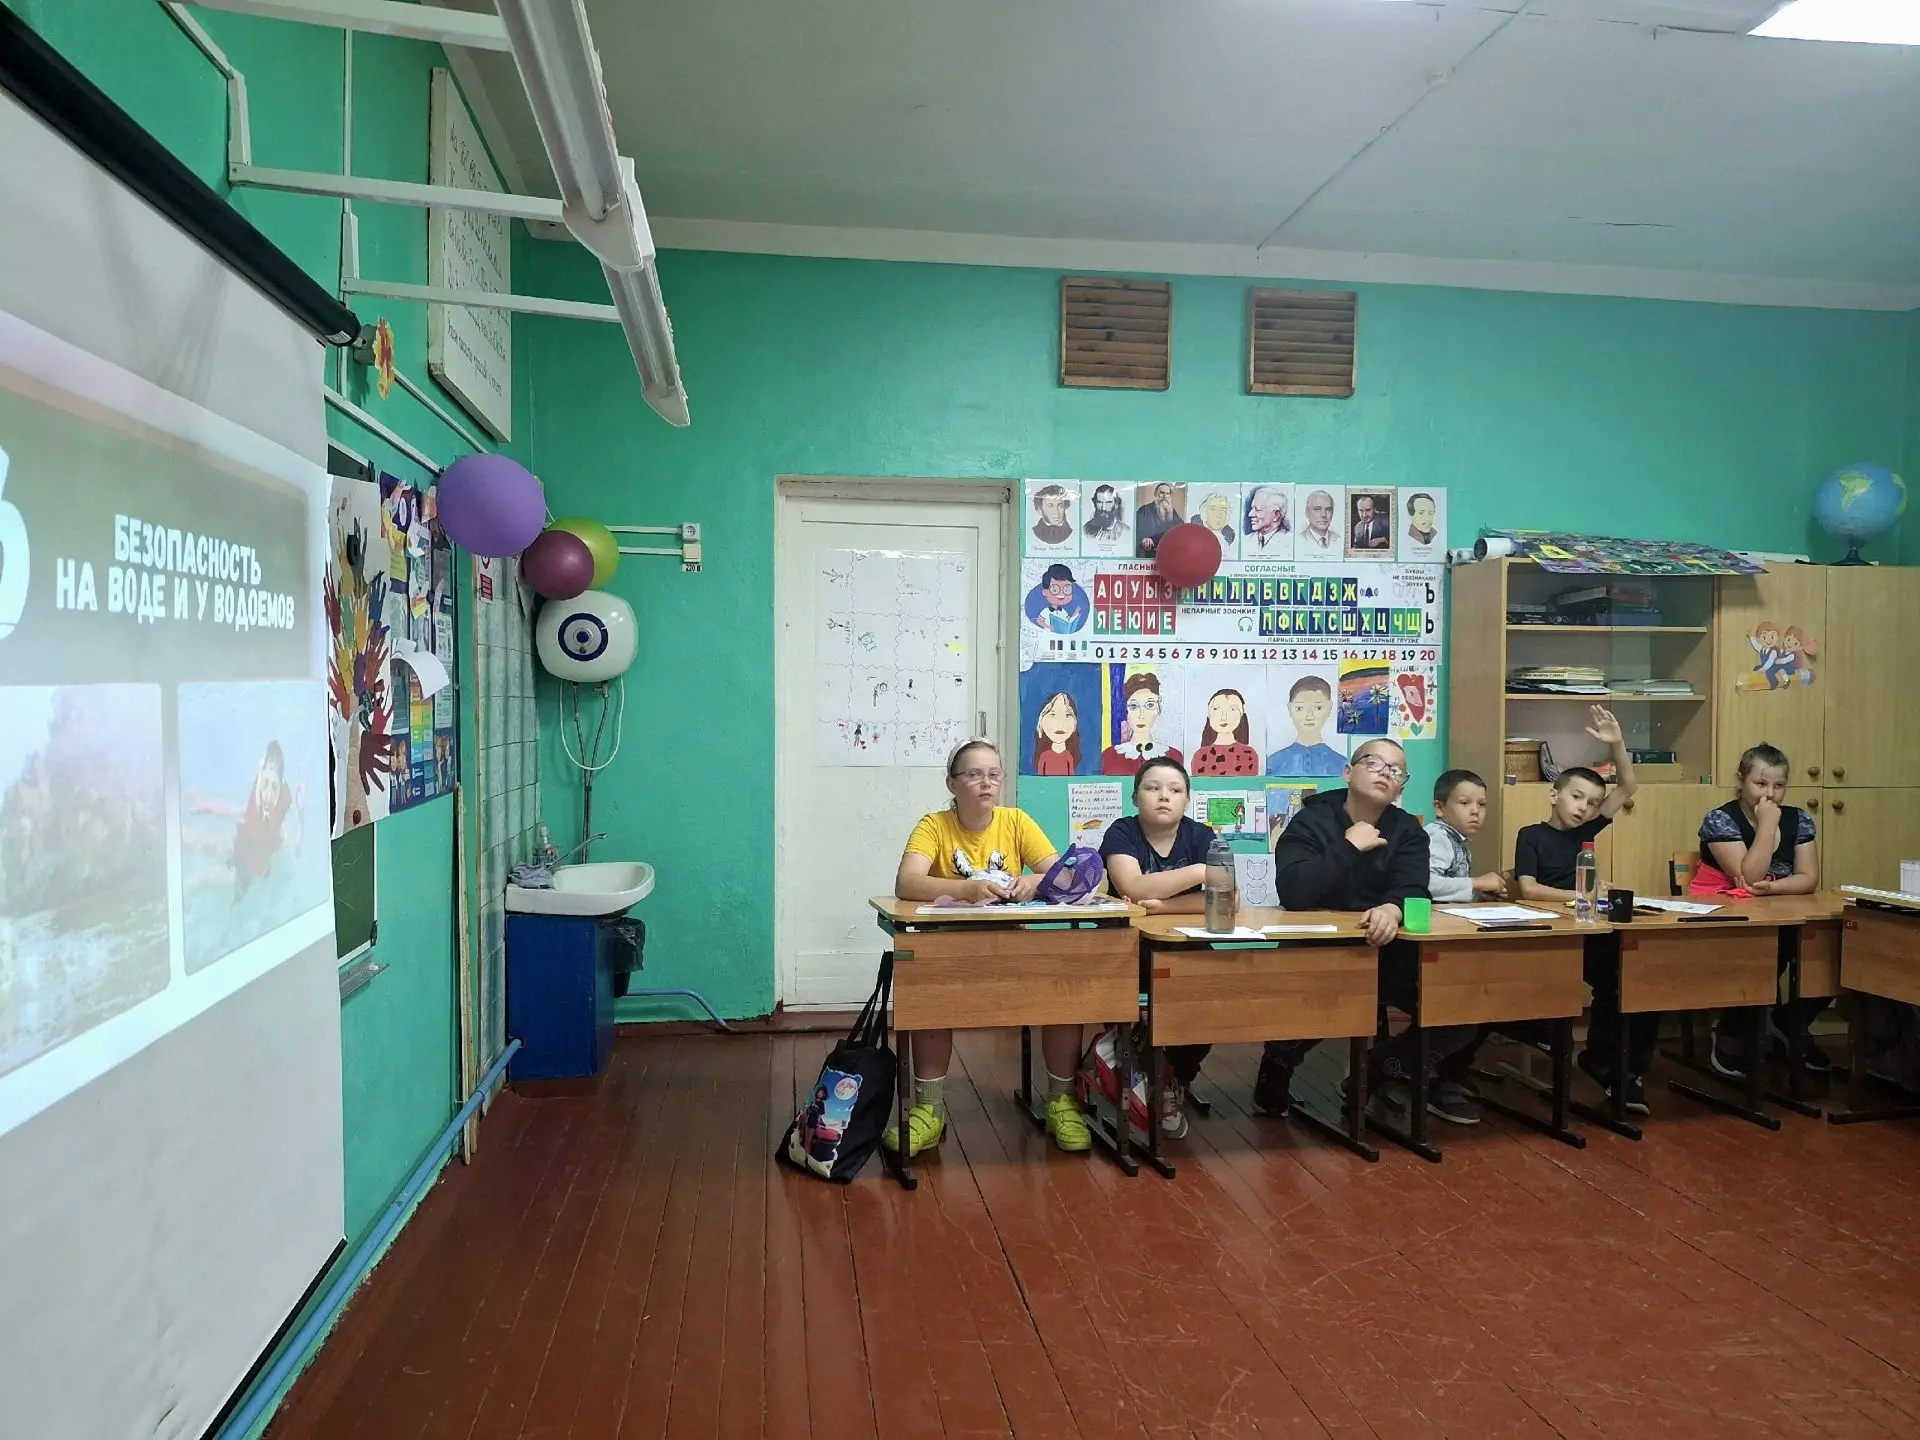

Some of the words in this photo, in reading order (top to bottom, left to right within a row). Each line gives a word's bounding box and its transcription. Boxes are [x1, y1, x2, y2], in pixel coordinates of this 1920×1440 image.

[114, 513, 262, 585] БЕЗОПАСНОСТЬ
[686, 564, 696, 572] 220
[1118, 563, 1159, 571] ГЛАСНЫЕ
[1244, 565, 1296, 573] СОГЛАСНЫЕ
[56, 558, 98, 611] НА
[108, 565, 166, 624] ВОДЕ
[174, 577, 189, 620] И
[195, 580, 209, 622] У
[213, 584, 295, 632] ВОДОЕМОВ
[1096, 580, 1107, 599] А
[1114, 580, 1123, 599] О
[1130, 580, 1140, 599] У
[1145, 581, 1158, 599] Ы
[1213, 582, 1223, 600] М
[1230, 582, 1240, 600] Л
[1247, 582, 1256, 600] Р
[1264, 583, 1272, 600] Б
[1280, 583, 1289, 600] В
[1297, 583, 1305, 600] Г
[1312, 582, 1322, 602] Д
[1330, 583, 1338, 601] З
[1343, 583, 1357, 601] Ж
[1097, 610, 1106, 629] Я
[1114, 609, 1122, 631] Ё
[1129, 611, 1141, 629] Ю
[1147, 611, 1156, 629] И
[1164, 611, 1172, 630] Е
[1263, 612, 1272, 631] П
[1279, 612, 1290, 631] Ф
[1296, 613, 1305, 631] К
[1312, 613, 1322, 631] Т
[1328, 613, 1337, 631] С
[1343, 613, 1357, 632] Ш
[1362, 613, 1371, 632] Х
[1378, 612, 1387, 633] Ц
[1394, 613, 1403, 632] Ч
[1407, 613, 1421, 633] Щ
[1426, 612, 1435, 634] Ь
[1095, 647, 1104, 658] 0
[1109, 647, 1115, 658] 1
[1120, 648, 1128, 658] 2
[1132, 648, 1141, 659] 3
[1145, 648, 1154, 659] 4
[1159, 648, 1167, 659] 5
[1172, 648, 1180, 659] 6
[1185, 648, 1193, 659] 7
[1197, 649, 1205, 659] 8
[1210, 649, 1218, 659] 9
[1223, 649, 1238, 659] 10
[1243, 649, 1257, 659] 11
[1262, 649, 1277, 660] 12
[1282, 649, 1297, 660] 13
[1302, 649, 1318, 660] 14
[1323, 649, 1338, 660] 15
[1343, 650, 1358, 660] 16
[1363, 650, 1379, 660] 17
[1382, 650, 1397, 660] 18
[1402, 650, 1415, 660] 19
[1420, 650, 1435, 661] 20
